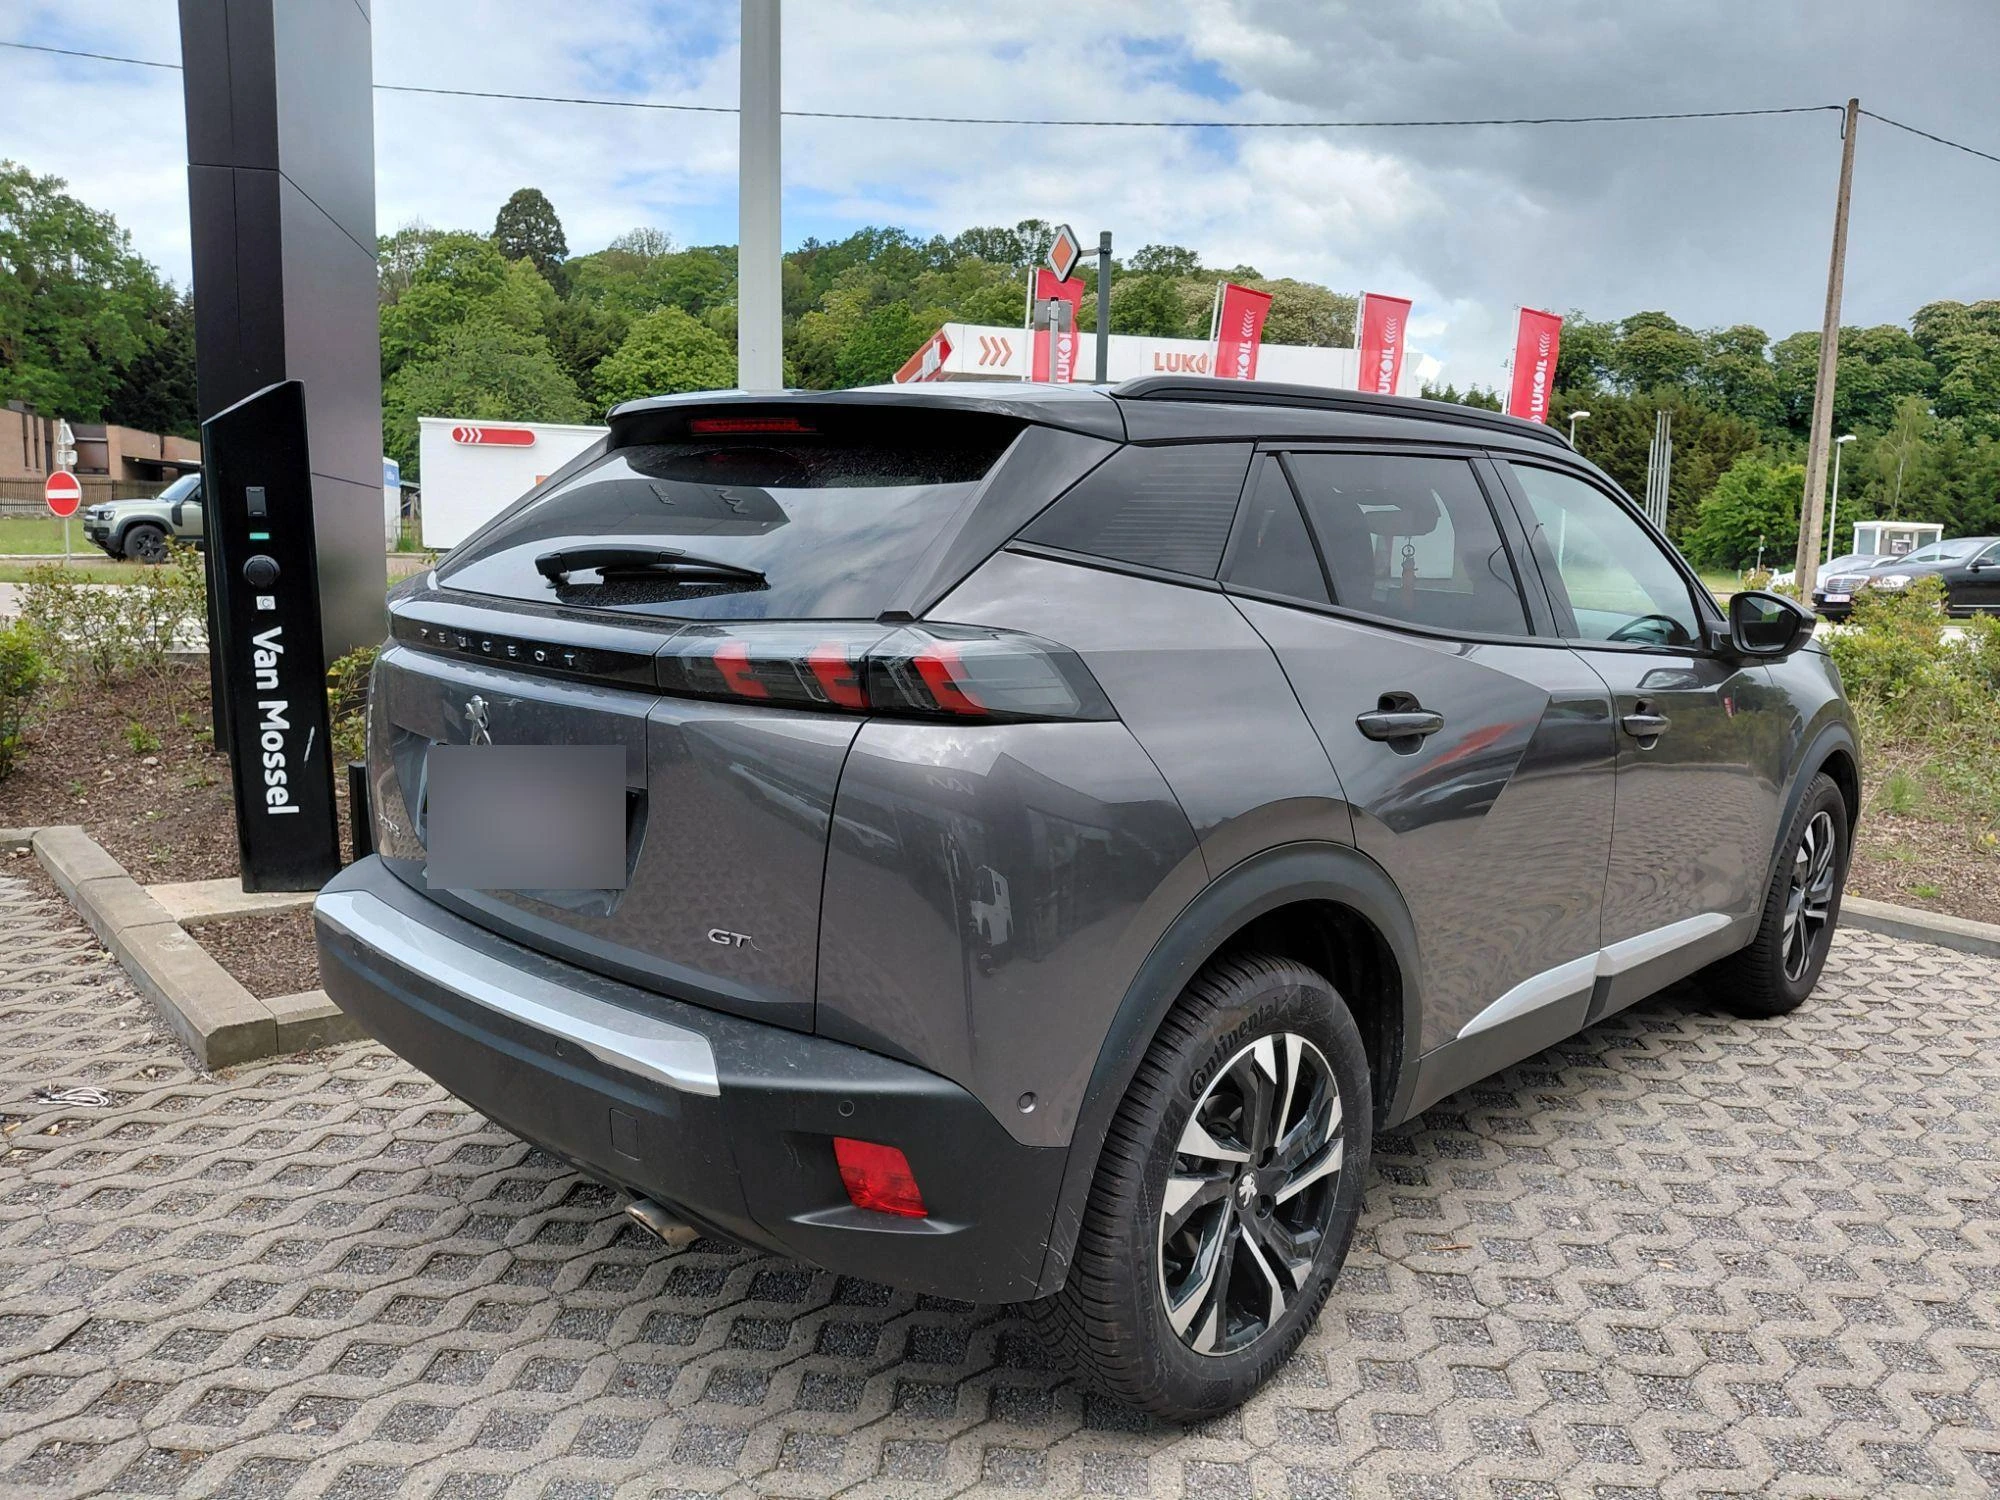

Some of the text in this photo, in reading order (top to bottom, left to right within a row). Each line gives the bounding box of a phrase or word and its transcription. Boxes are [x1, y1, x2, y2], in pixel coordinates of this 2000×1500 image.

[1057, 332, 1073, 384] LUKOI
[1154, 352, 1210, 374] LUKO
[1237, 340, 1253, 380] KOIL
[1378, 346, 1395, 395] UKOIL
[1530, 359, 1548, 413] LUKOIL
[420, 627, 575, 666] PEUGEOT
[252, 626, 300, 815] Van Mossel
[707, 928, 752, 948] GT
[1189, 996, 1279, 1101] Continental
